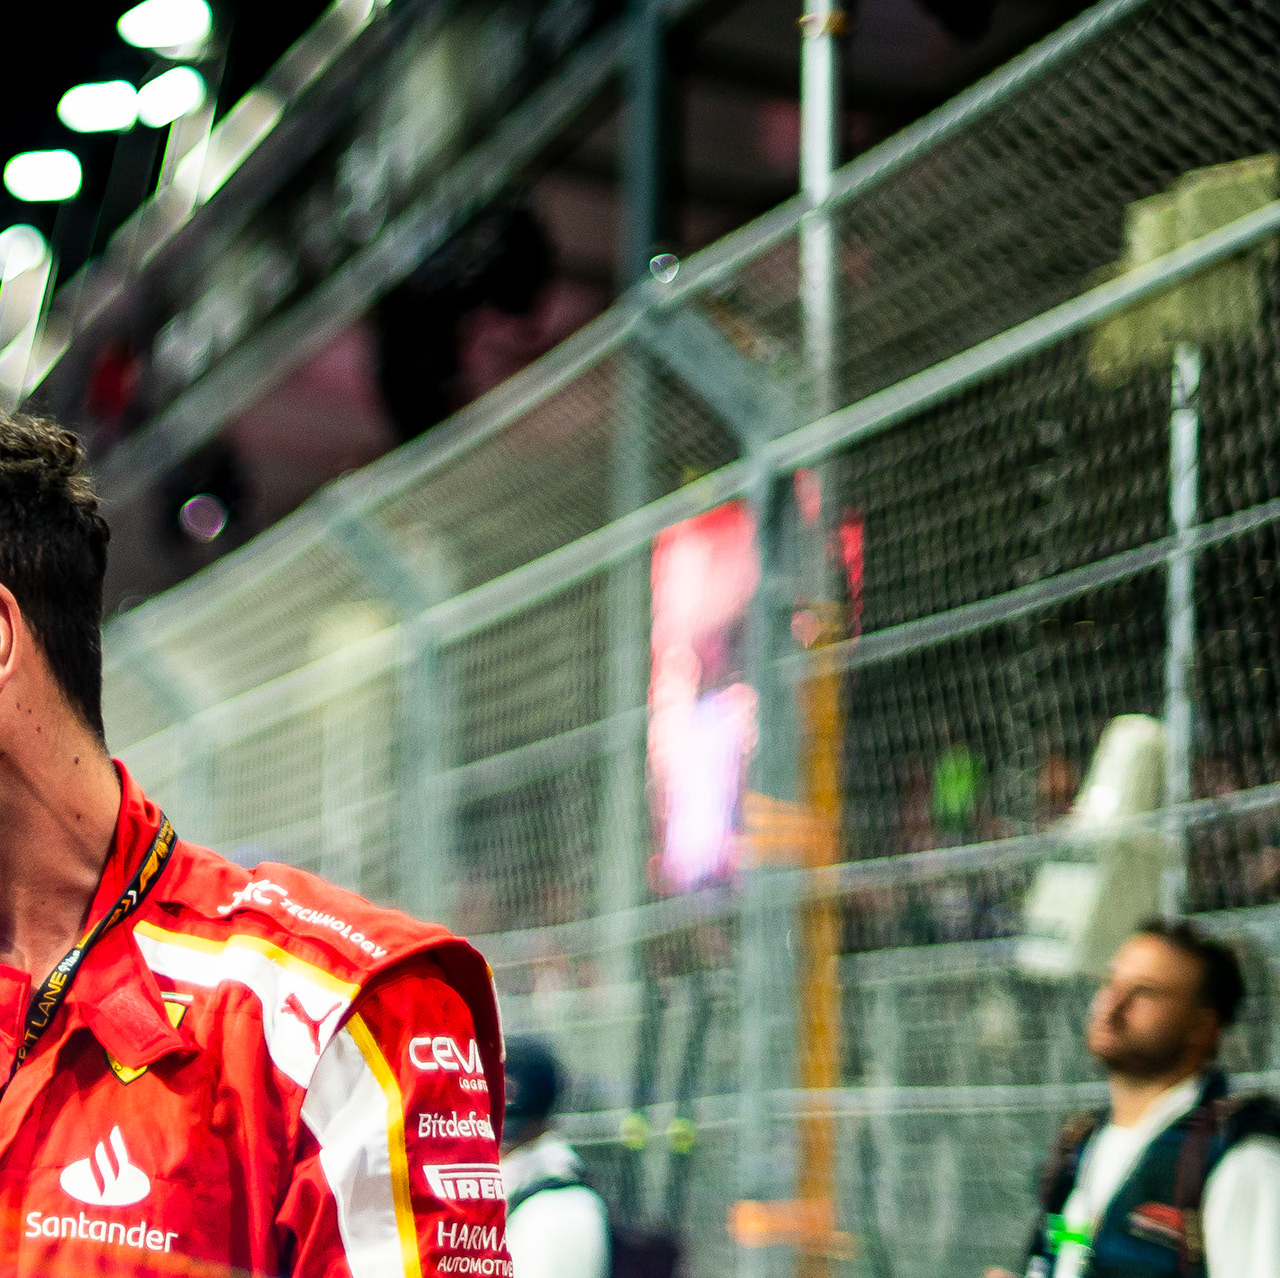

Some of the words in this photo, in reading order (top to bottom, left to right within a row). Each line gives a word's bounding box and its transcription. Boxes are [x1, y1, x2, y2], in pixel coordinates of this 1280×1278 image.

[280, 898, 388, 958] TECHNOLOGY
[17, 1030, 38, 1060] PIT
[30, 971, 68, 1028] LANE
[417, 1111, 497, 1141] Bitdefed
[422, 1164, 507, 1200] PIREL
[25, 1211, 179, 1253] Santander
[437, 1221, 508, 1252] HARMA
